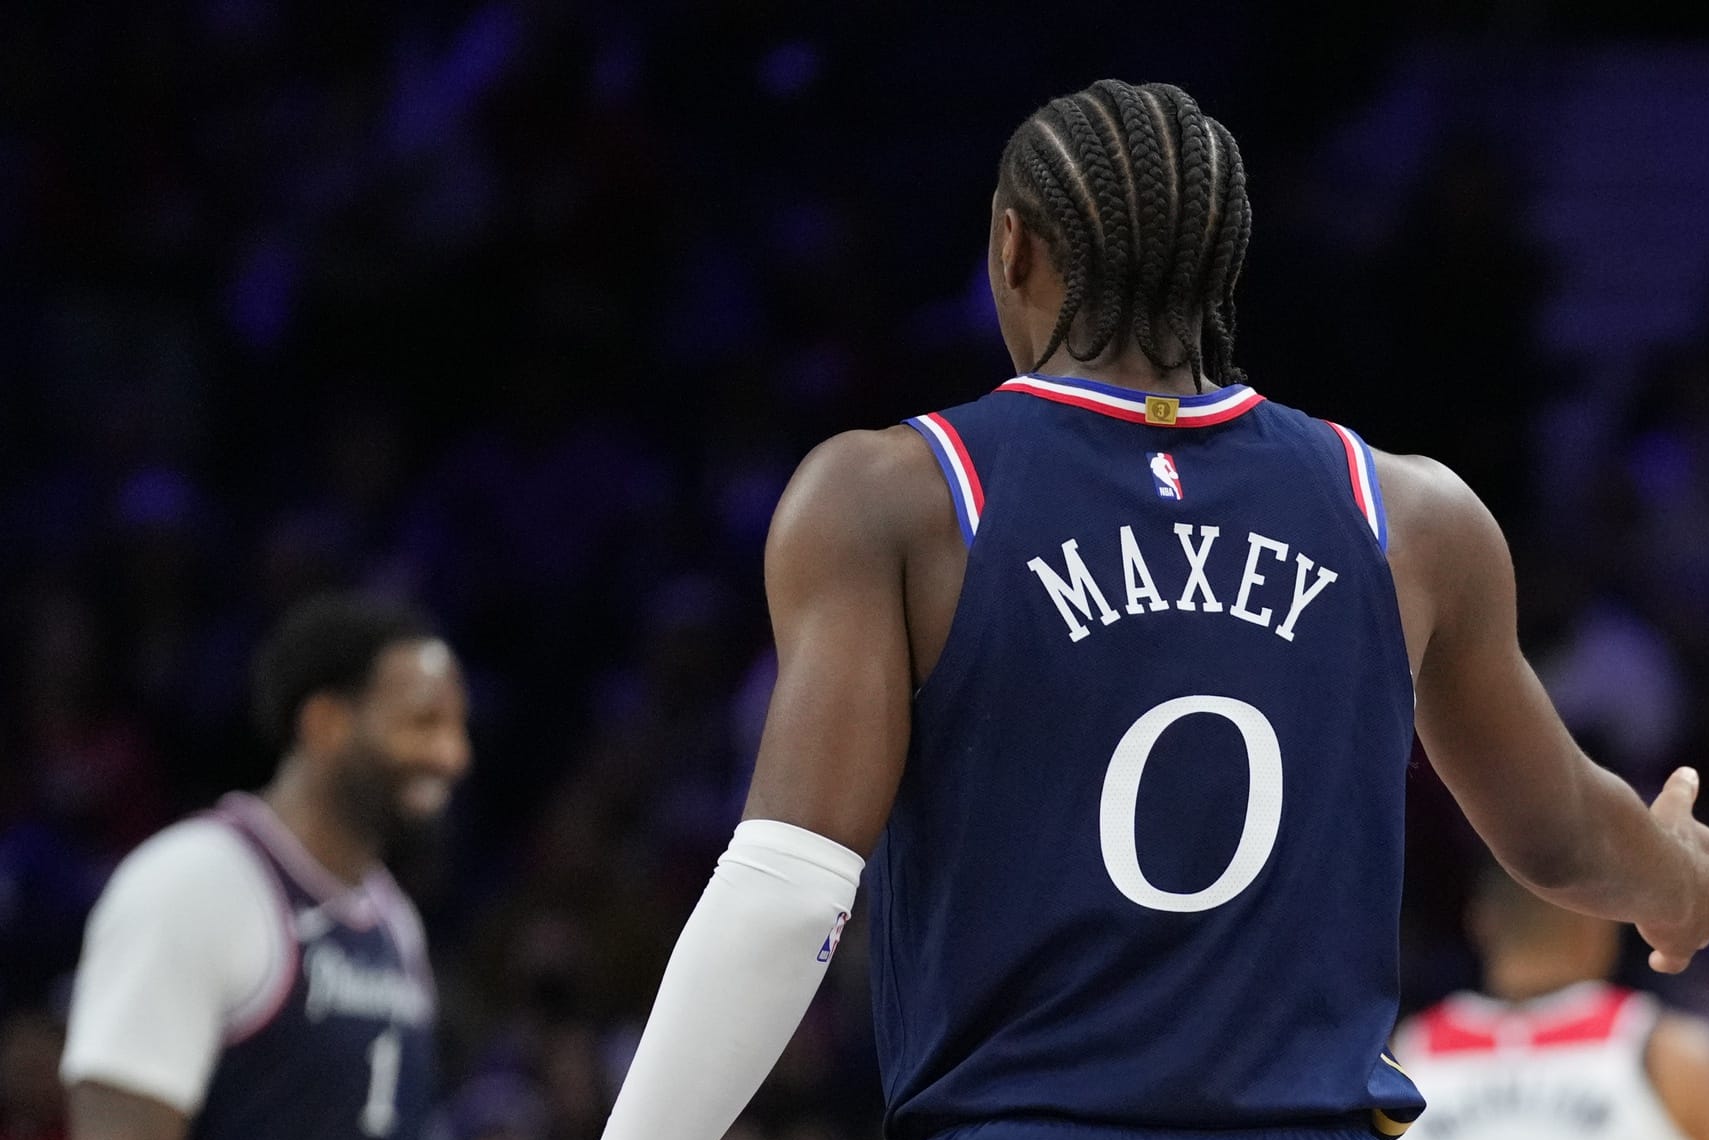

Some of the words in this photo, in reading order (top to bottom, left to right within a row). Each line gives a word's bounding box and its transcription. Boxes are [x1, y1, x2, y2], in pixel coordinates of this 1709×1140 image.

[1026, 522, 1339, 643] MAXEY
[1099, 694, 1284, 913] 0
[359, 1030, 401, 1138] 1
